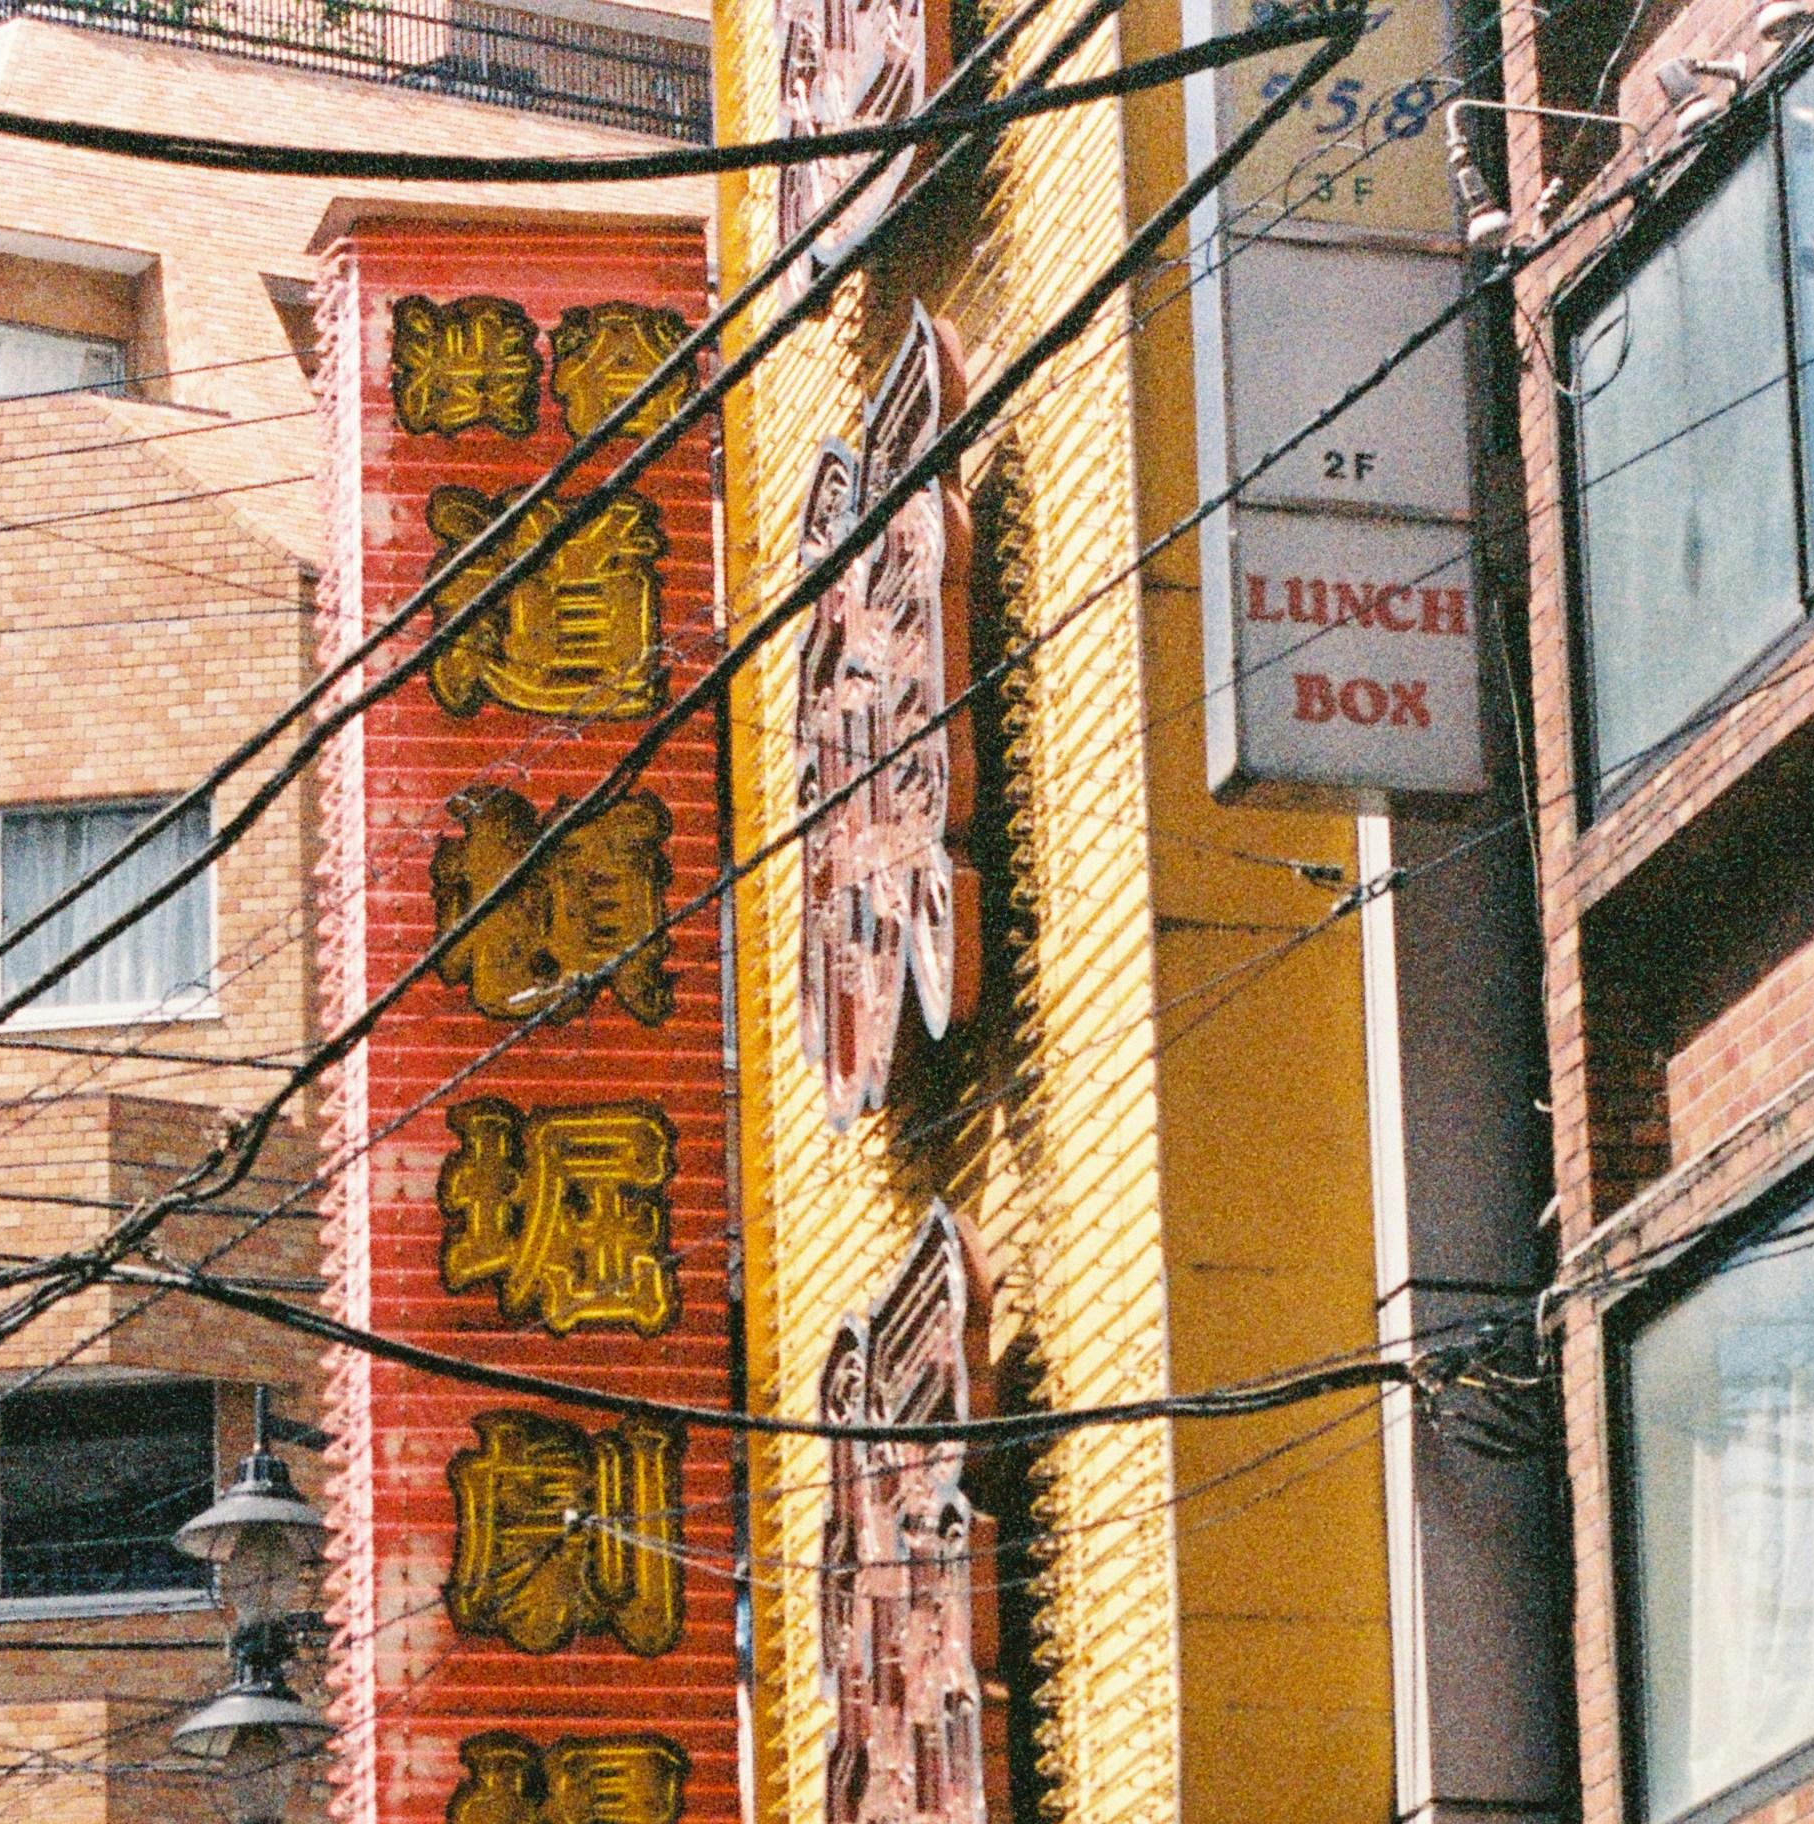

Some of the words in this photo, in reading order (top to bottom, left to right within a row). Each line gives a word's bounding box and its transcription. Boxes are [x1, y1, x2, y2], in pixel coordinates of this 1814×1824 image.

[1322, 448, 1377, 484] 2F
[1245, 572, 1469, 638] LUNCH
[1291, 670, 1432, 732] BOX
